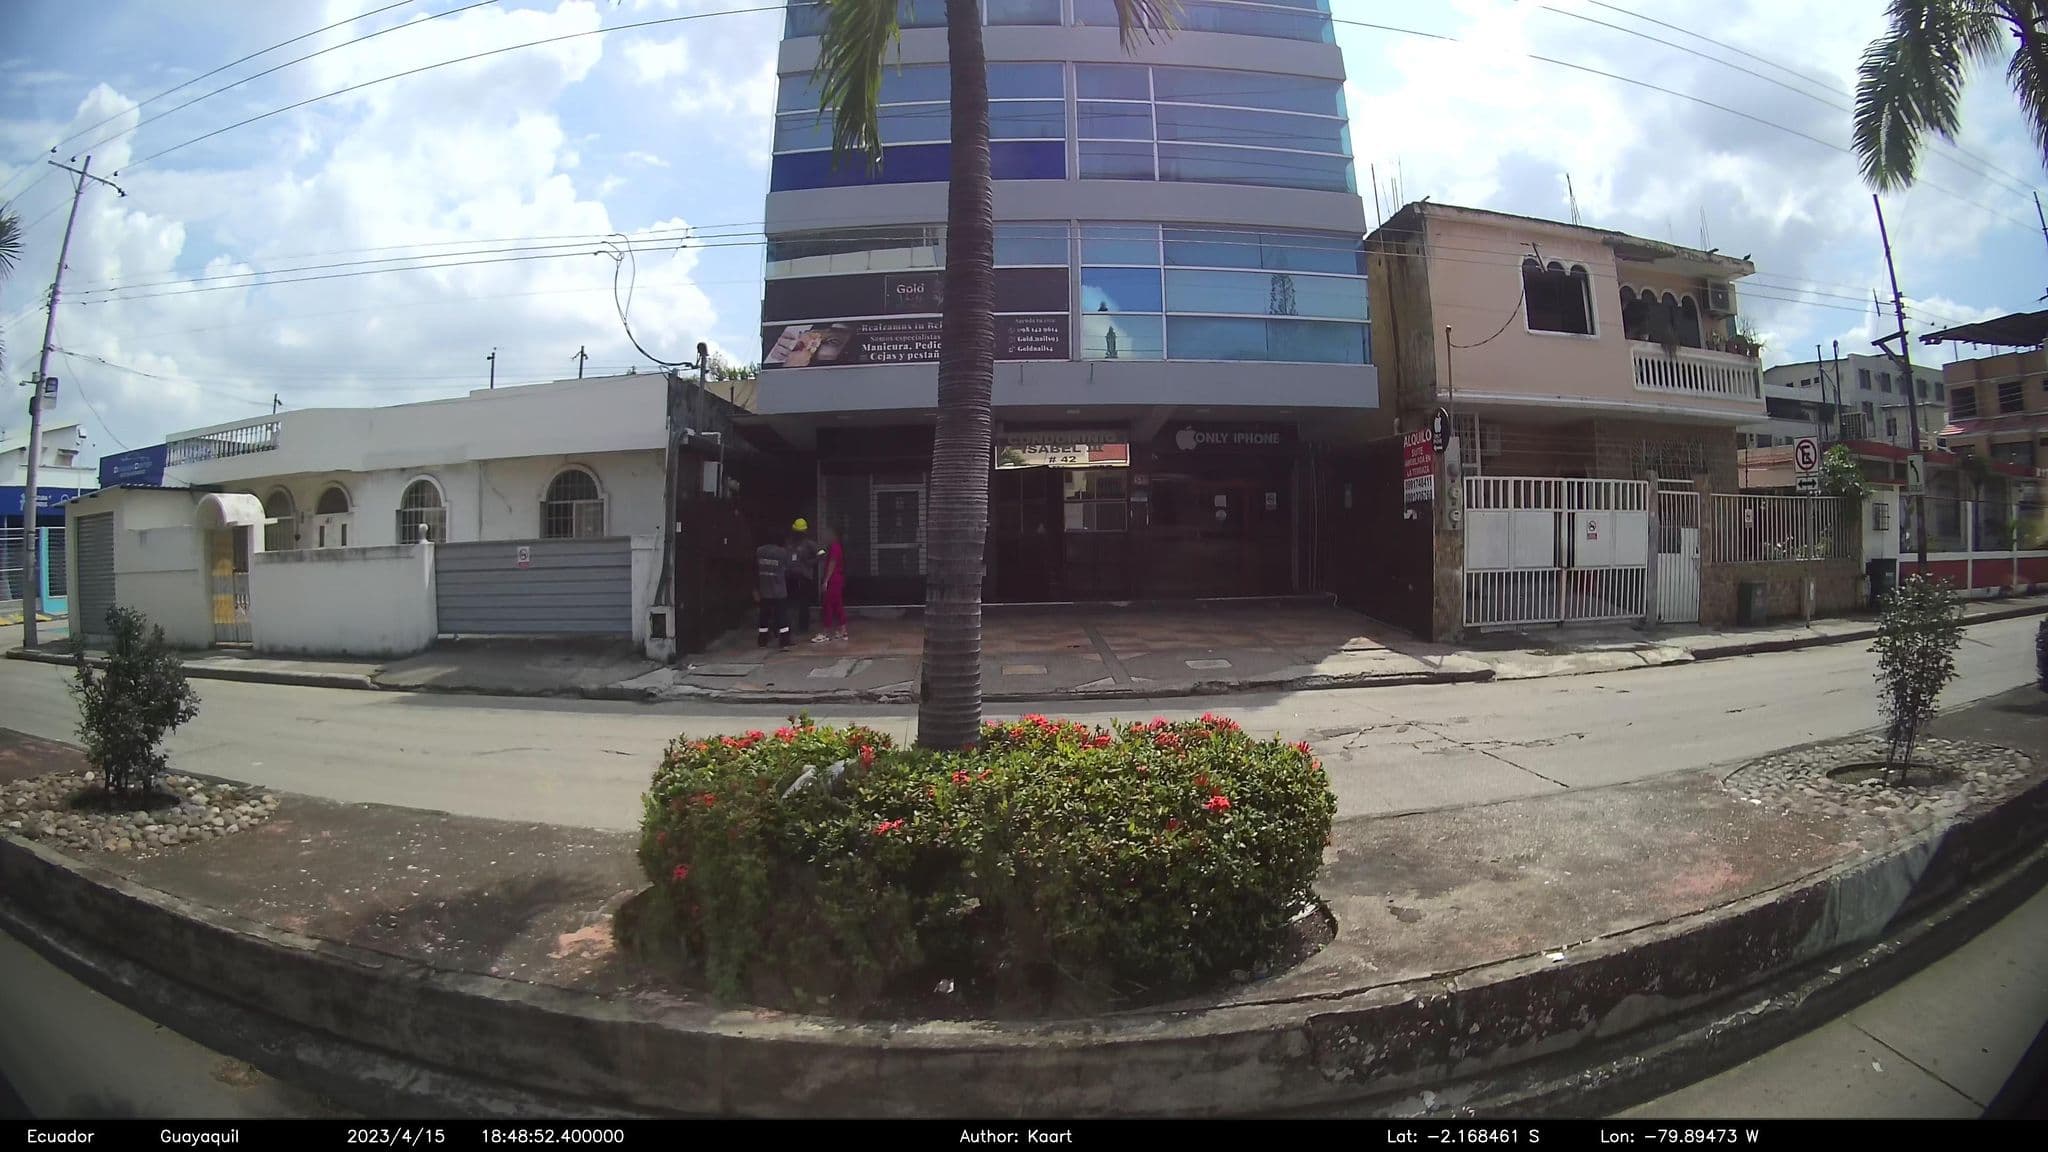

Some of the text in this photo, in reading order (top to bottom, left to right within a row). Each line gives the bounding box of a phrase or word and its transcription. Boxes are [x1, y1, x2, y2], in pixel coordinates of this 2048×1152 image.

[896, 283, 925, 294] Gold
[894, 334, 942, 342] especialistas
[914, 341, 943, 350] Pedic
[870, 350, 941, 361] Cejas y pestañ
[1195, 432, 1280, 444] ONLY IPHONE
[1403, 428, 1432, 449] ALQUILO
[1048, 455, 1077, 463] # 42
